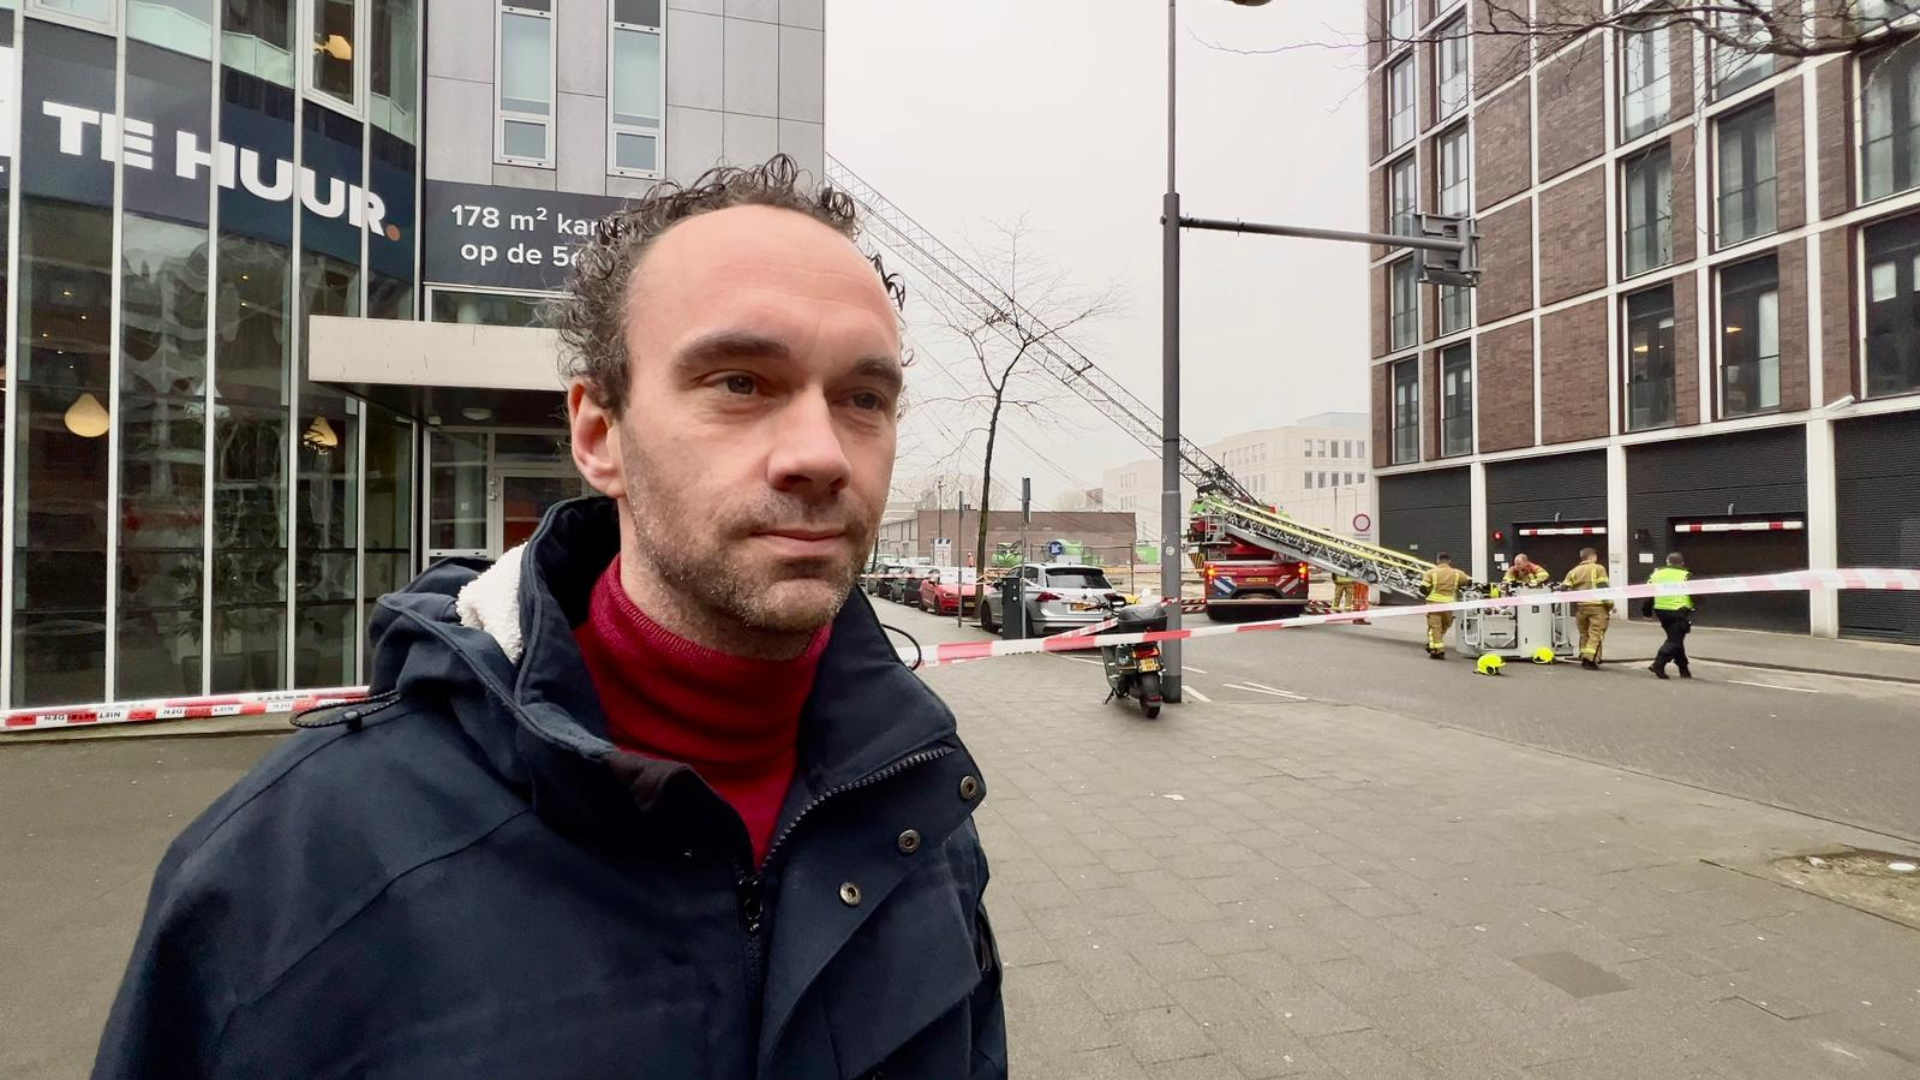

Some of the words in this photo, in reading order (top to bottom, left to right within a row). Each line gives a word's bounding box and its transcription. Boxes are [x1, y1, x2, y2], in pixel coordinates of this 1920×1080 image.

[42, 100, 154, 170] TE
[175, 130, 400, 241] HUUR.
[451, 204, 499, 228] 178
[460, 243, 497, 266] op
[507, 243, 543, 265] de
